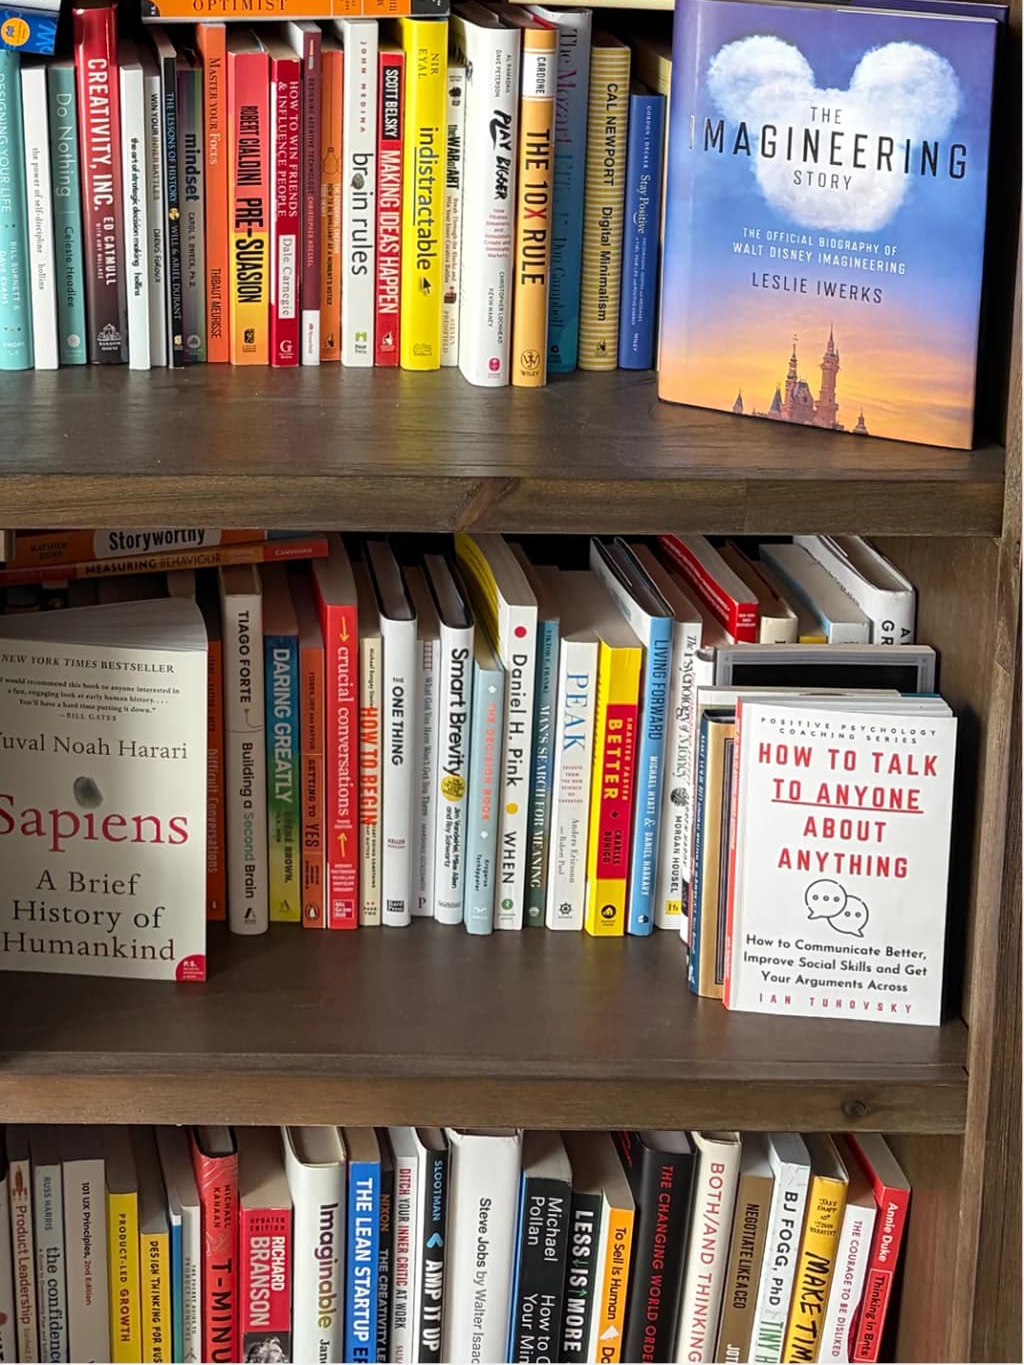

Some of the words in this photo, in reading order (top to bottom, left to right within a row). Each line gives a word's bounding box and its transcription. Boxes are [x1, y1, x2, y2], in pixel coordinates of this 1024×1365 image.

[86, 58, 114, 170] CREATIVITY,
[810, 107, 842, 124] THE
[525, 129, 551, 170] THE
[689, 116, 967, 178] IMAGINEERING
[91, 173, 114, 212] INC.
[415, 127, 439, 270] indistractable
[793, 170, 852, 190] STORY
[524, 179, 547, 221] 10X
[235, 196, 264, 304] PRE-SUASION
[520, 229, 546, 285] RULE
[751, 272, 808, 294] LESLIE
[817, 280, 882, 303] IWERKS
[563, 672, 591, 751] PEAK
[53, 737, 110, 757] Noah
[117, 740, 188, 760] Harari
[758, 742, 812, 769] HOW
[829, 748, 857, 771] TO
[870, 752, 938, 778] TALK
[773, 777, 802, 803] TO
[816, 781, 922, 810] ANYONE
[802, 816, 887, 844] ABOUT
[36, 870, 56, 890] A
[68, 872, 141, 895] Brief
[778, 848, 908, 879] ANYTHING
[12, 899, 120, 932] History
[133, 907, 165, 928] of
[2, 931, 176, 961] Humankind
[354, 1177, 372, 1212] THE
[478, 1197, 492, 1234] Steve
[527, 1196, 545, 1246] Pollan
[543, 1197, 563, 1262] Michael
[575, 1210, 594, 1259] LESS
[884, 1203, 898, 1233] Annie
[354, 1217, 371, 1262] LEAN
[476, 1237, 489, 1267] Jobs
[878, 1235, 892, 1262] Duke
[249, 1237, 270, 1327] BRANSON
[270, 1236, 285, 1292] RICHARD
[313, 1203, 339, 1328] Imaginable
[351, 1266, 370, 1343] STARTUP
